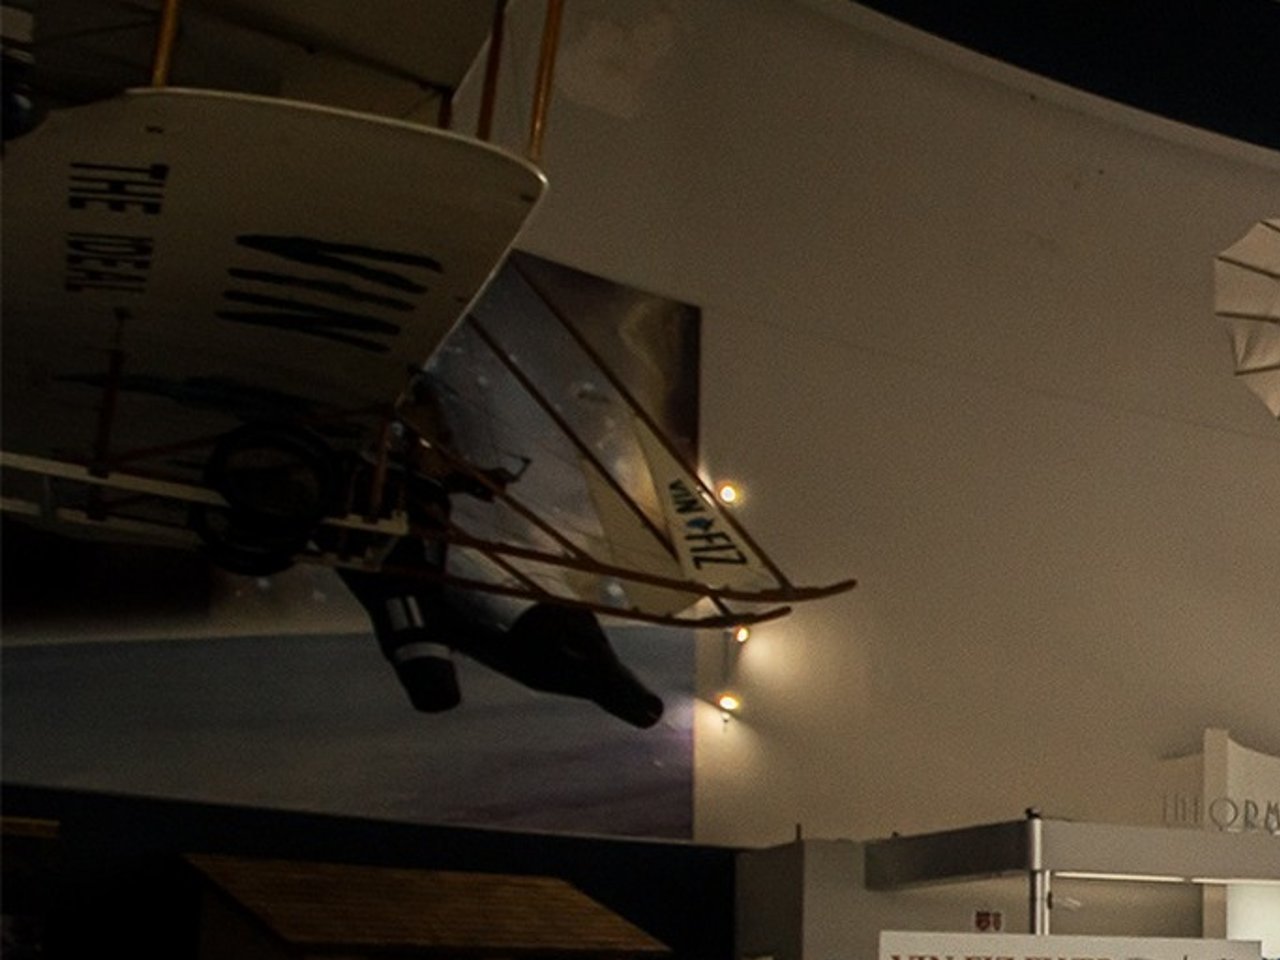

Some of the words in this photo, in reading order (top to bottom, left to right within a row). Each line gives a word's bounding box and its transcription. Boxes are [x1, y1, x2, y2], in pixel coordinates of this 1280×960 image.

[70, 162, 169, 213] THE
[66, 232, 153, 292] IDEAL
[215, 235, 444, 352] VIN
[668, 477, 707, 515] VIN
[685, 531, 747, 570] FIZ
